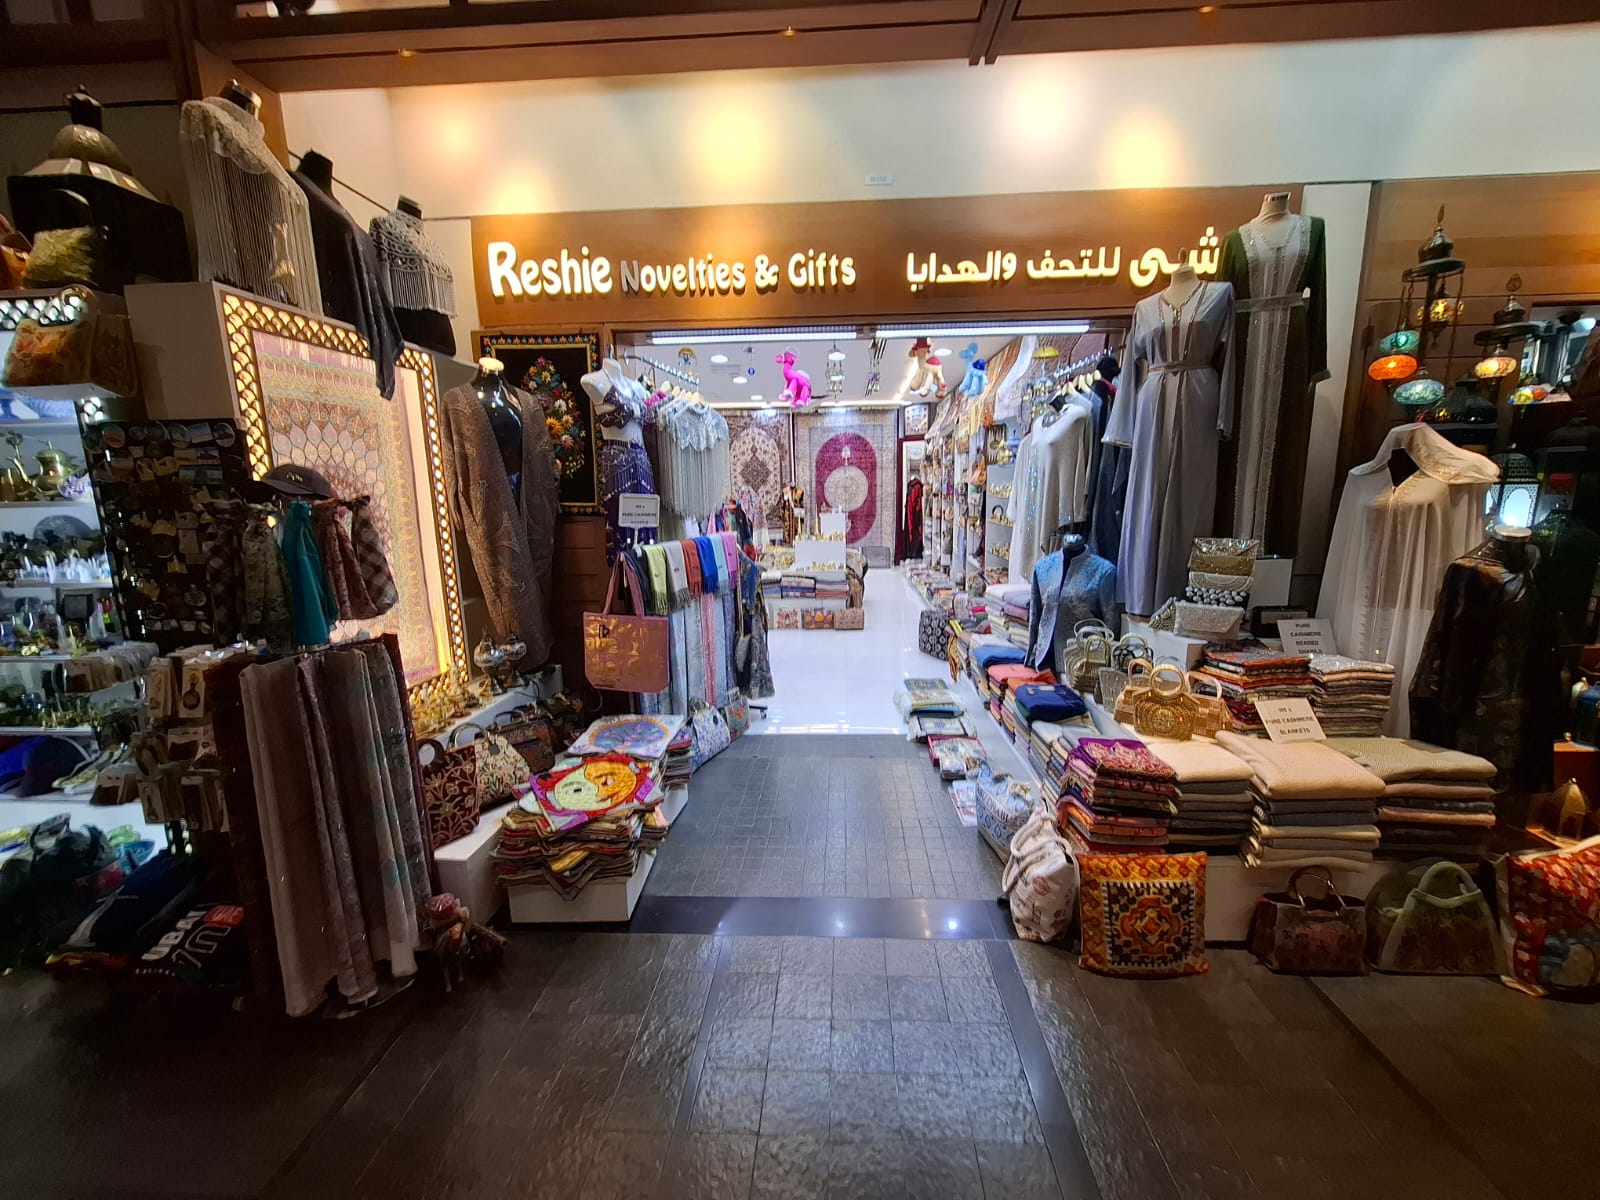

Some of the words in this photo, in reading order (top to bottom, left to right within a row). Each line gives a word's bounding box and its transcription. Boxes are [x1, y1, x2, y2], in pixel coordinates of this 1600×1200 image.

[488, 241, 613, 297] Reshie
[621, 254, 746, 294] Novelties
[754, 254, 779, 290] &
[788, 248, 857, 289] Gifts
[907, 250, 1018, 292] والهدايا
[1026, 246, 1121, 279] للتحف
